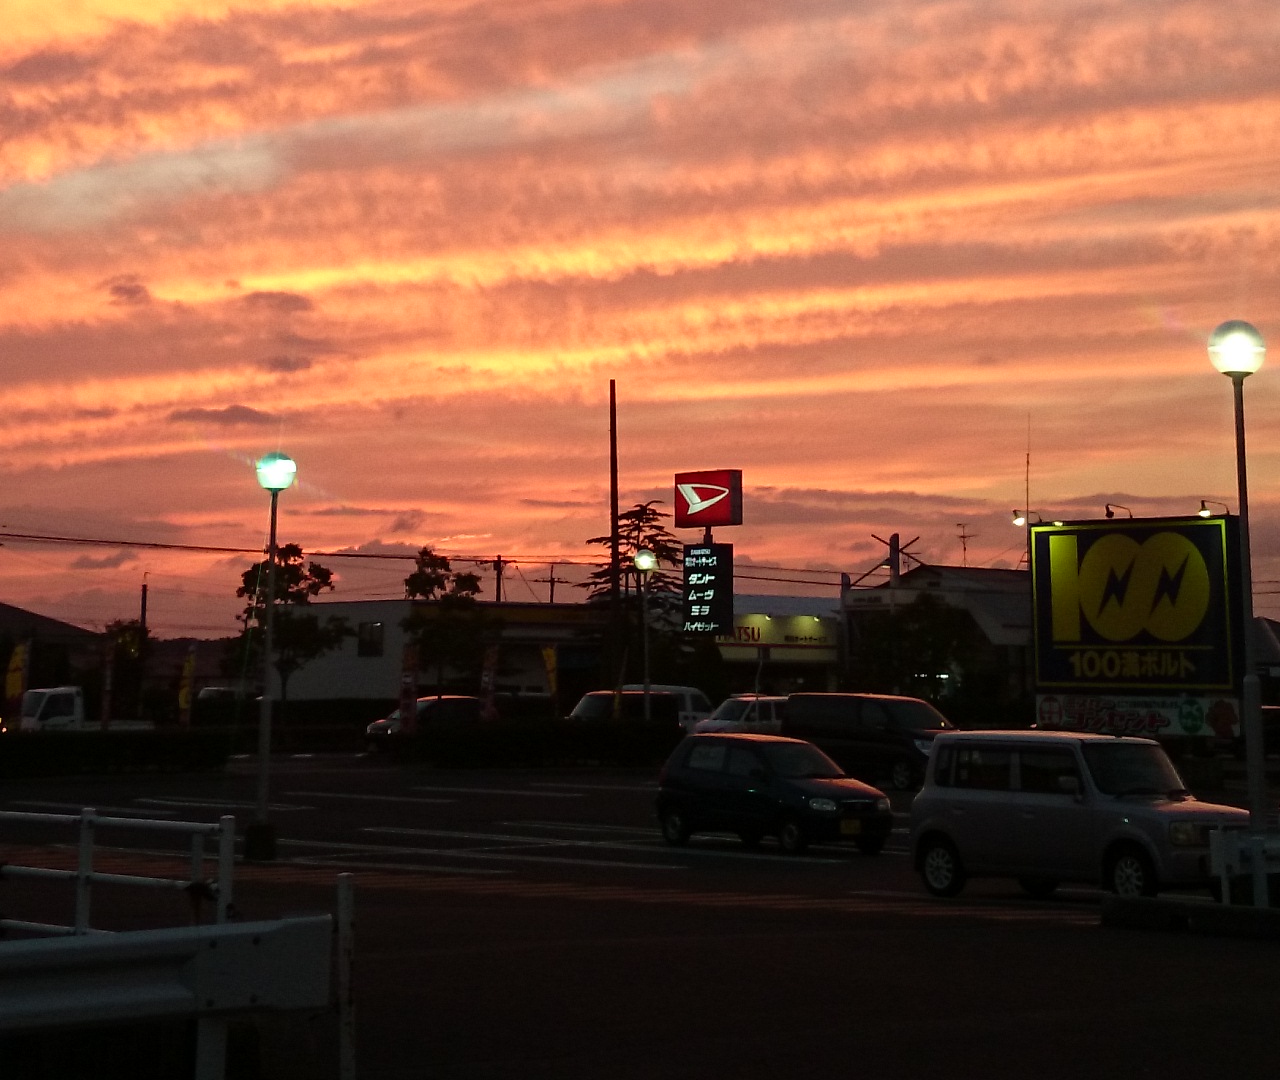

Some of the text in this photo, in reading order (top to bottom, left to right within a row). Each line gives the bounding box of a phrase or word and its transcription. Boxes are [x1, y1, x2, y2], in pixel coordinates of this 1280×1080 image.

[688, 573, 715, 585] タント
[688, 589, 714, 601] ムーヴ
[690, 605, 710, 616] ミラ
[683, 622, 719, 632] ハイゼット
[1068, 650, 1196, 678] 100満ボルト
